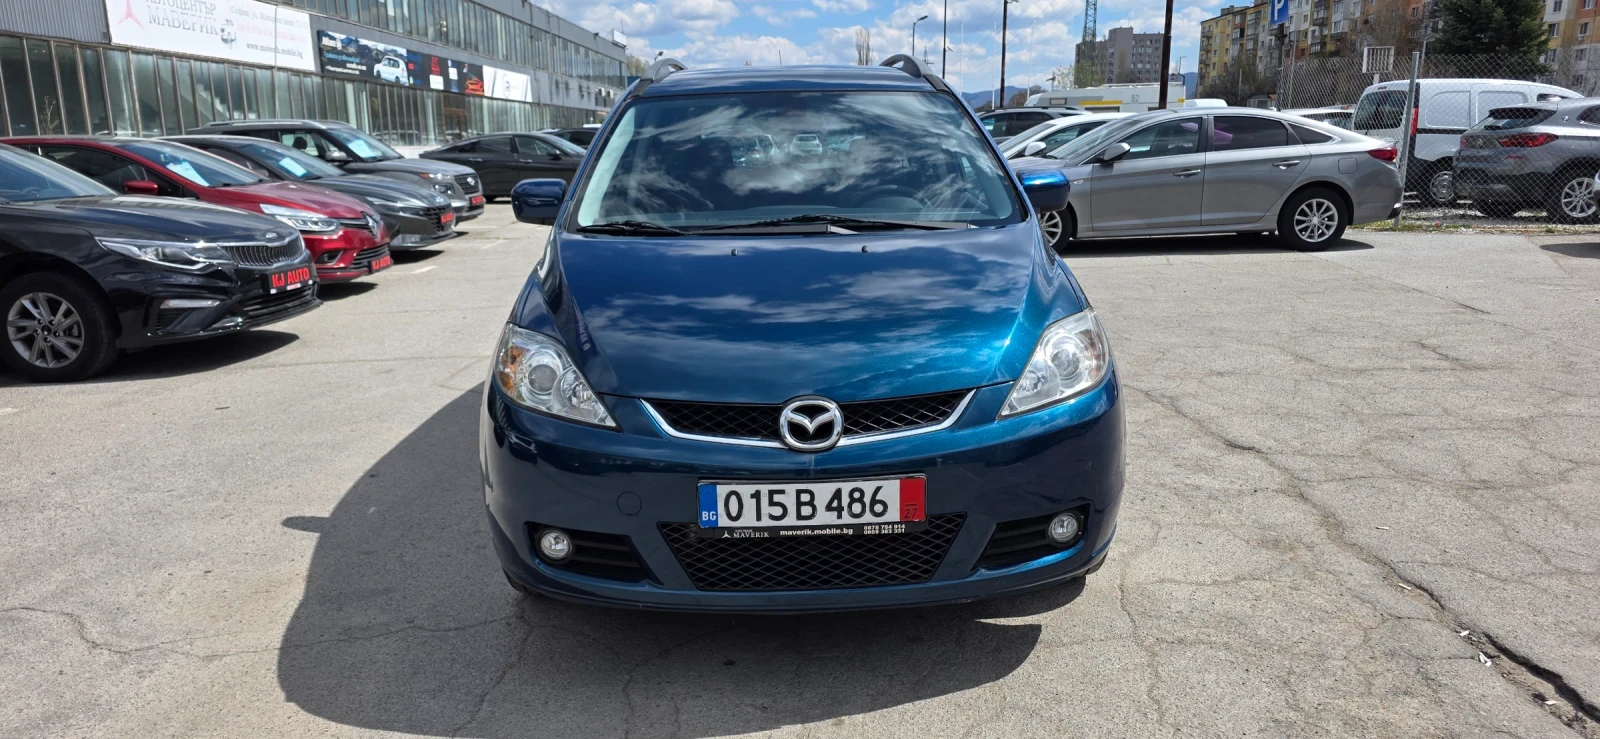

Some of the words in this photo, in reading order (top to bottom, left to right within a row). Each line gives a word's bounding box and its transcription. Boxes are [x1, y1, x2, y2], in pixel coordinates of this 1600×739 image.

[145, 0, 217, 15] ОЦЕНТЪР
[1274, 0, 1284, 20] P
[146, 5, 219, 35] МАВЕРИК
[272, 273, 285, 287] KJ
[287, 267, 310, 284] AUTO
[702, 511, 716, 521] BG
[904, 508, 918, 519] 27
[780, 527, 853, 535] maverik.mobile.bg
